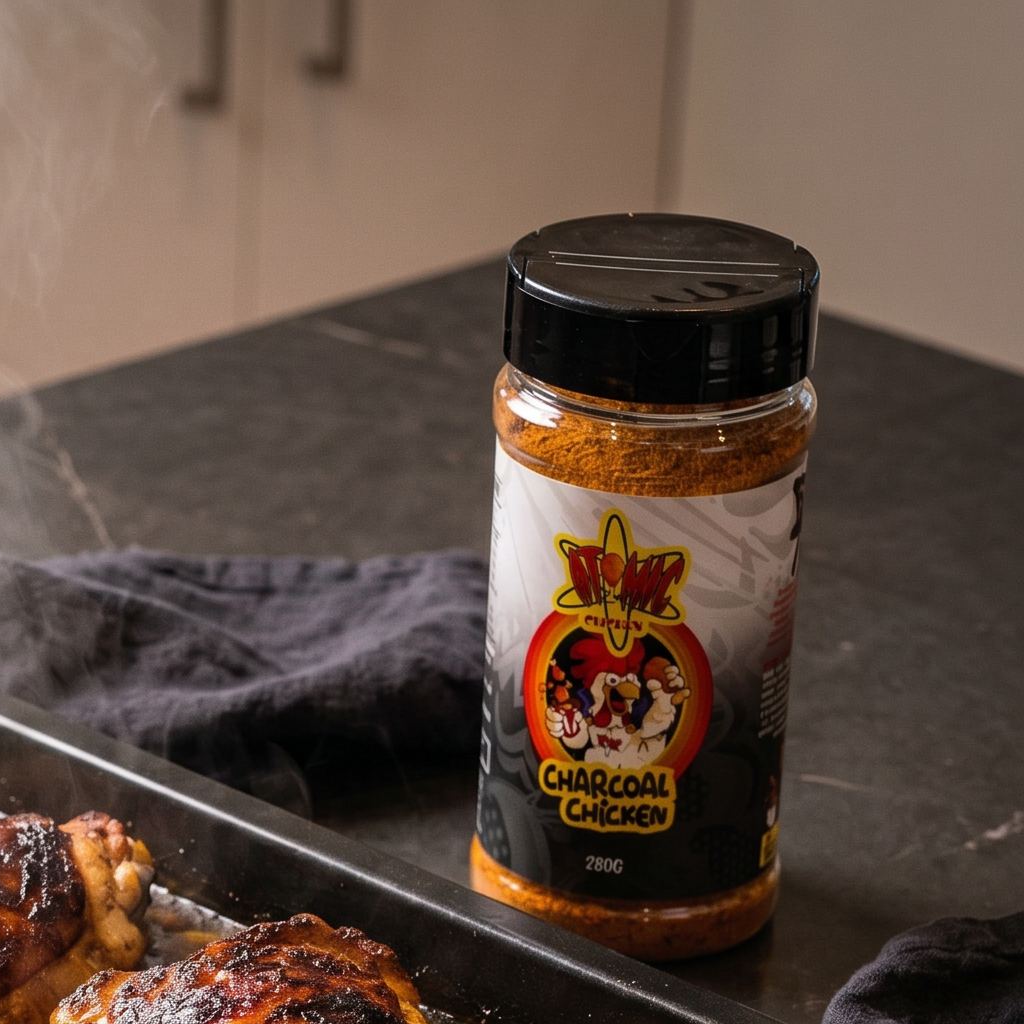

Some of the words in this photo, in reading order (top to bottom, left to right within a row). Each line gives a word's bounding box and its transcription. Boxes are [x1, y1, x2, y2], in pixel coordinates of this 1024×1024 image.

[543, 764, 669, 799] CHARCOAL
[565, 798, 668, 828] CHICKEN
[585, 855, 624, 874] 280G
